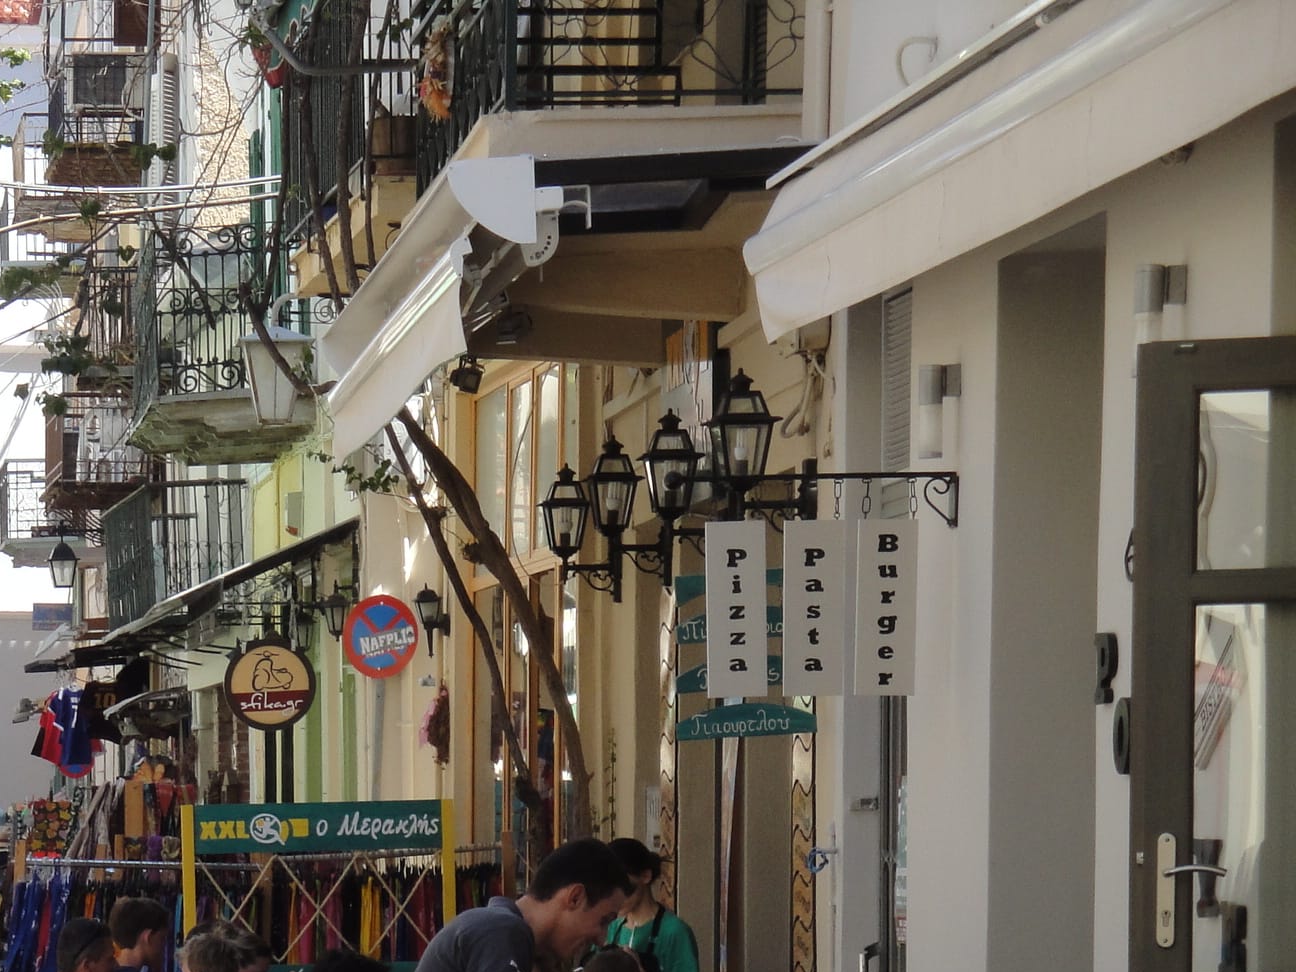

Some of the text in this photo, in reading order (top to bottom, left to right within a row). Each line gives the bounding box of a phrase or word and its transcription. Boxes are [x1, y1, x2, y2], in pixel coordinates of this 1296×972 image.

[726, 548, 747, 671] Pizza
[804, 548, 825, 671] Pasta
[877, 534, 899, 685] Burger
[240, 690, 304, 717] sfika.gr
[336, 811, 439, 839] Μερακλής
